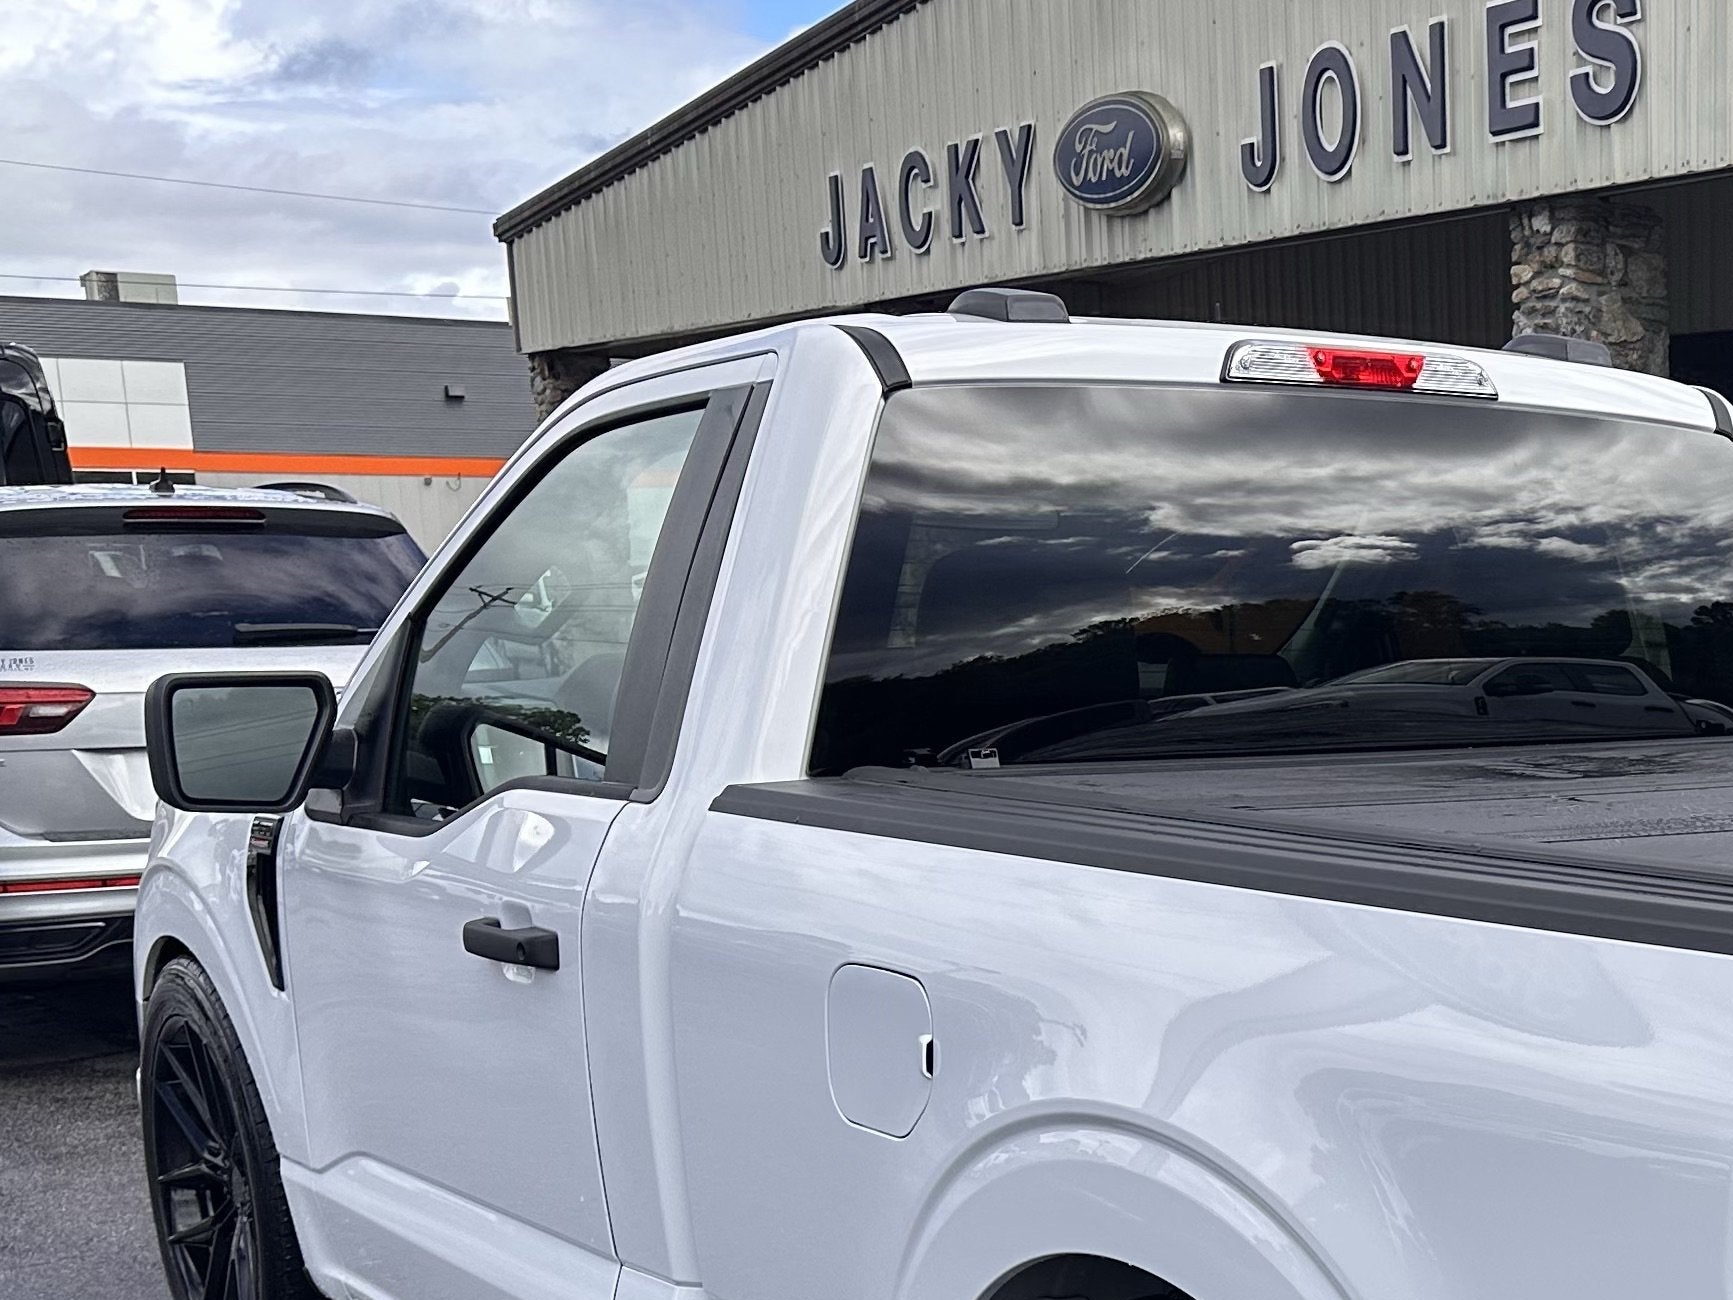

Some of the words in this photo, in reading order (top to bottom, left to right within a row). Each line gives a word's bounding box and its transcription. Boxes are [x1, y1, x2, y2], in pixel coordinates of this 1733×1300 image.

[820, 120, 1036, 269] JACKY
[1071, 120, 1135, 187] Ford
[1240, 0, 1643, 192] JONES
